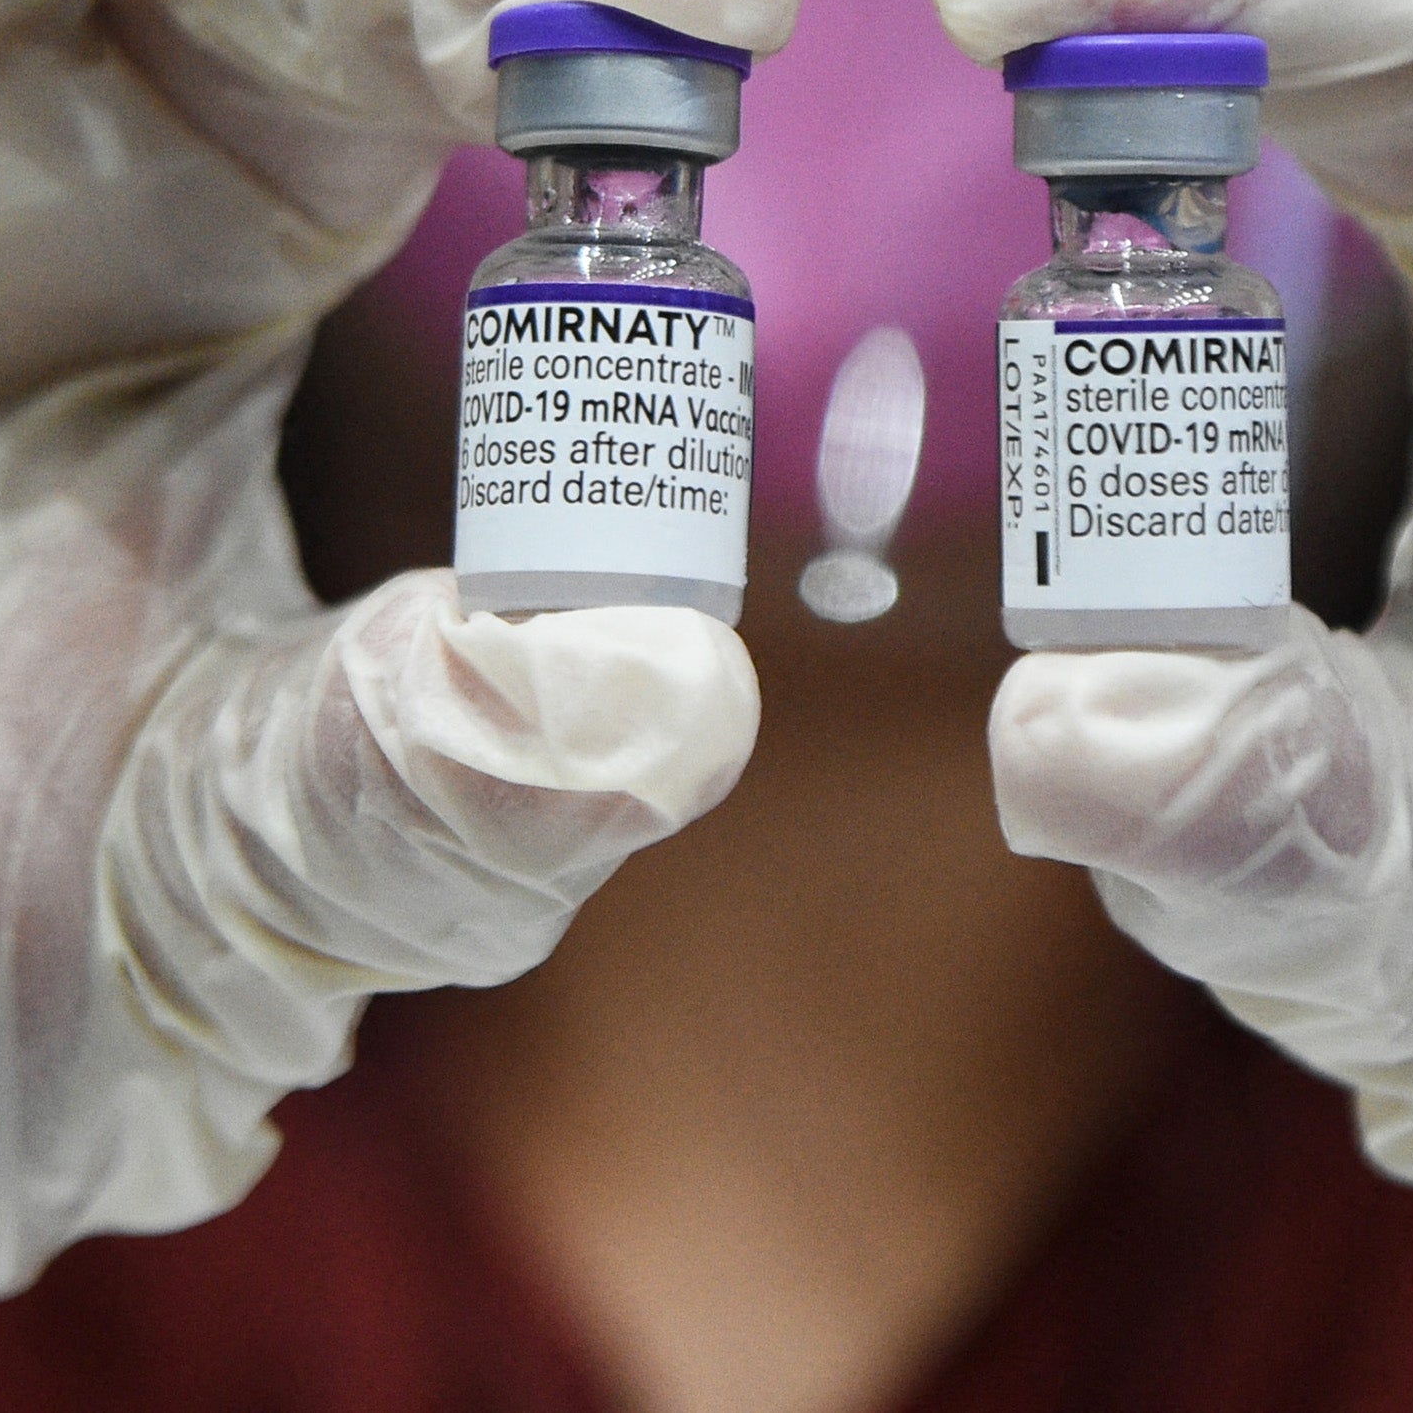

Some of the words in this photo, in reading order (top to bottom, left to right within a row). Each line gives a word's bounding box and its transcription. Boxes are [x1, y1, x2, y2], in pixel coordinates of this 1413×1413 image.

[464, 349, 524, 386] sterile
[534, 353, 722, 389] concentrate
[1065, 337, 1284, 376] COMIRNAT
[463, 390, 571, 428] COVID-19
[581, 394, 678, 428] mRNA
[688, 397, 753, 440] Vaccine
[1066, 379, 1169, 413] sterile
[1003, 338, 1024, 530] LOT/EXP:
[1032, 354, 1051, 513] PAA174601
[1067, 421, 1219, 456] COVID-19
[1229, 420, 1285, 453] mRNA
[461, 437, 470, 470] 6
[474, 435, 555, 468] doses
[570, 431, 655, 467] after
[668, 437, 751, 482] dilution
[460, 470, 550, 511] Discard
[563, 471, 729, 516] date/time:
[1069, 464, 1087, 498] 6
[1100, 463, 1208, 498] doses
[1222, 461, 1277, 495] after
[1069, 503, 1207, 538] Discard
